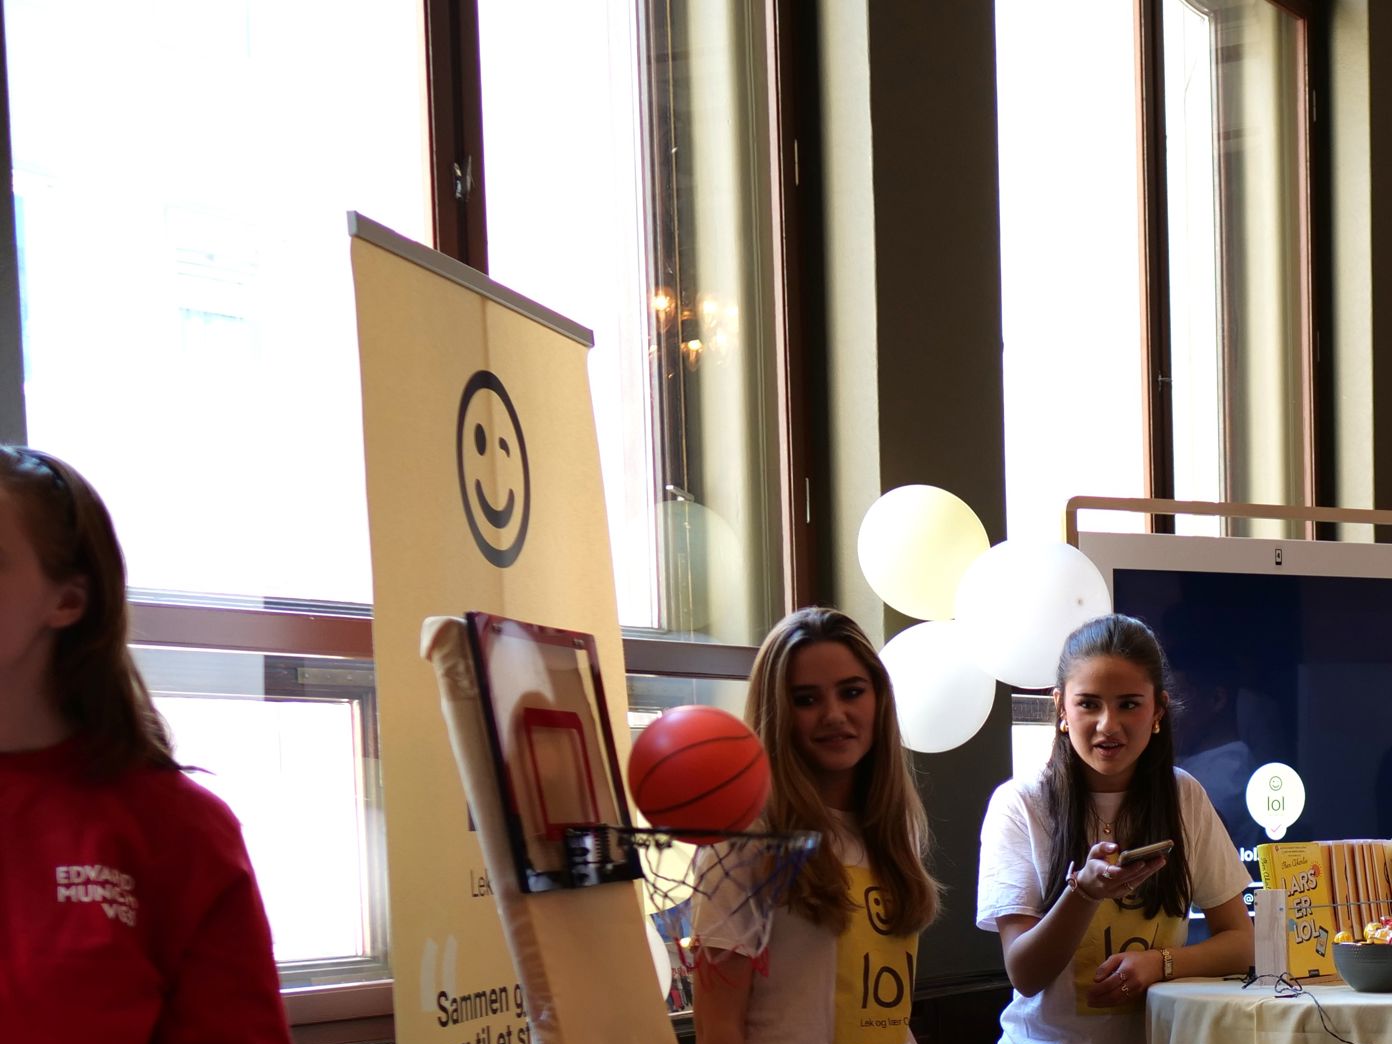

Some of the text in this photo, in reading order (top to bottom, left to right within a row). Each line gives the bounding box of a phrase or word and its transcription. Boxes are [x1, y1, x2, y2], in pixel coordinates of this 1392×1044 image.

[1267, 796, 1285, 811] lol
[56, 864, 135, 891] EDVARD
[470, 868, 494, 897] Lek
[1281, 869, 1318, 897] LARS
[57, 884, 138, 909] MUNCH
[1293, 896, 1313, 919] ER
[1293, 919, 1321, 944] LOL
[861, 951, 914, 1009] lol
[437, 986, 509, 1027] Sammen
[860, 1016, 874, 1027] Lek
[875, 1018, 887, 1029] og
